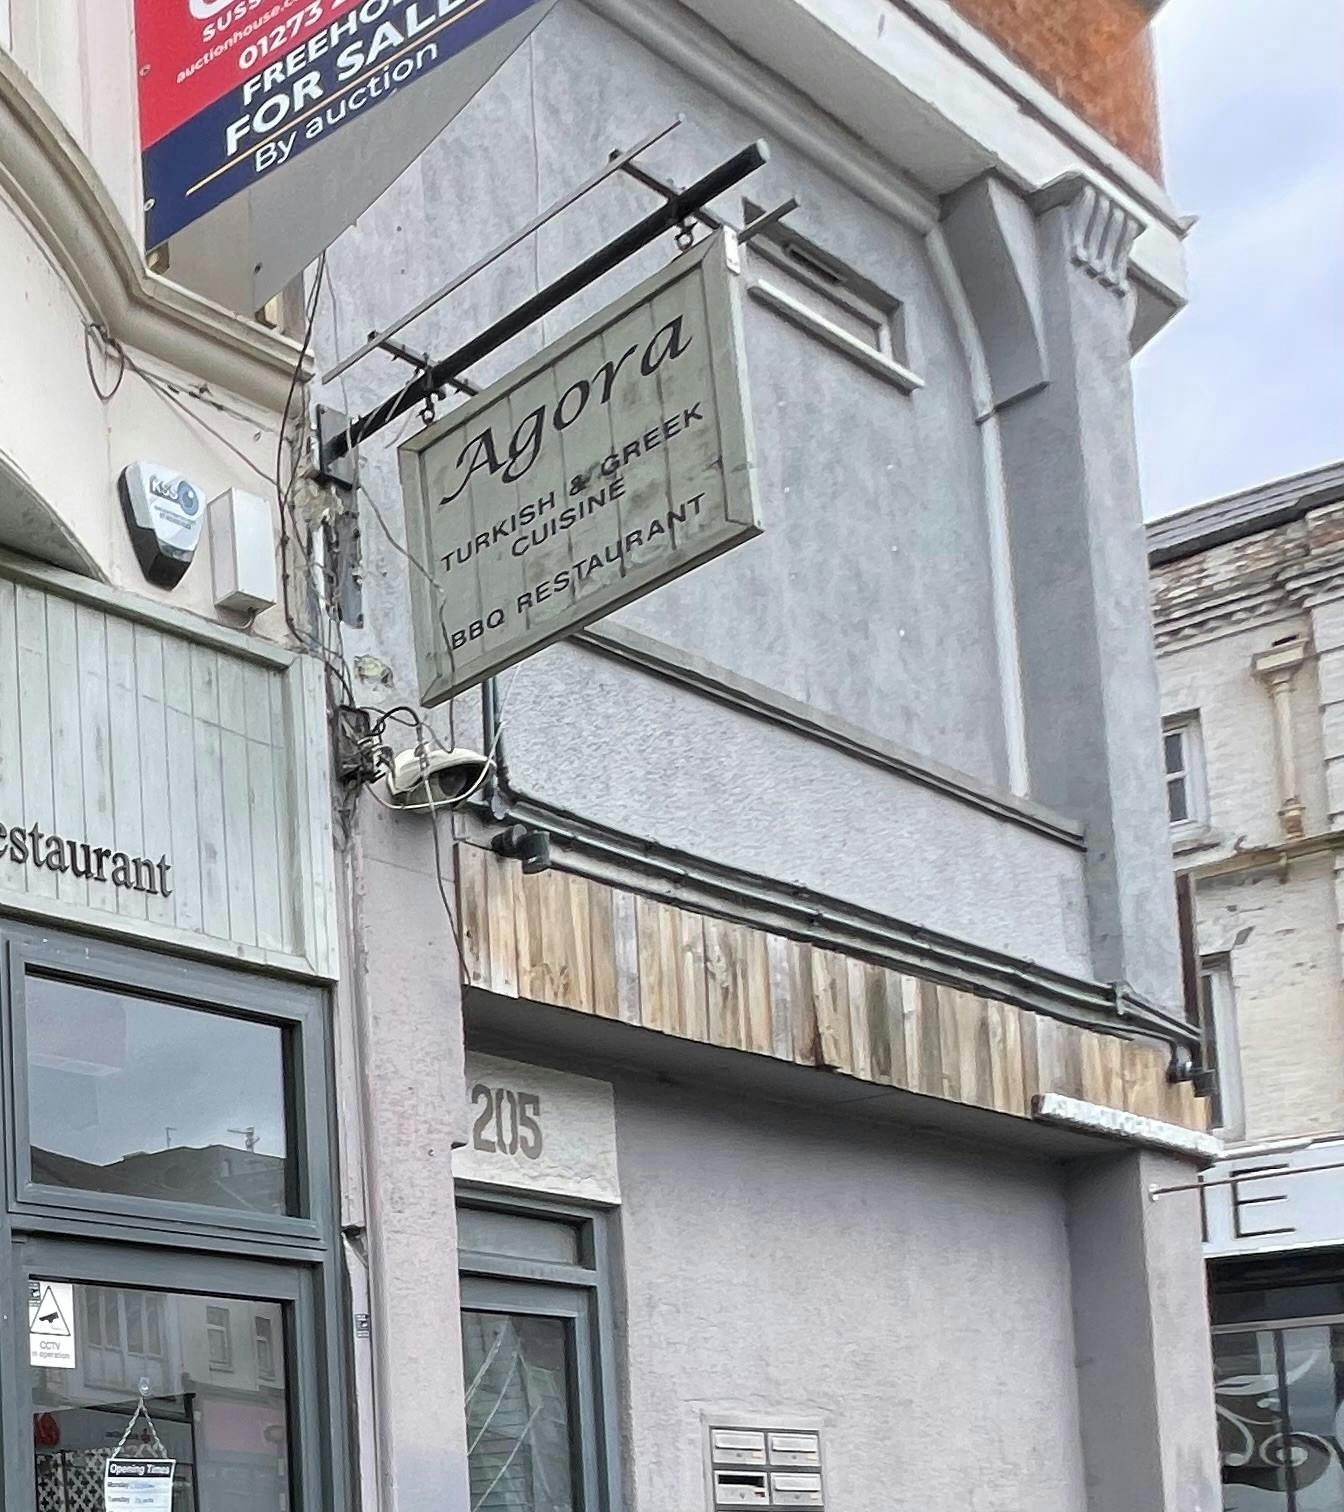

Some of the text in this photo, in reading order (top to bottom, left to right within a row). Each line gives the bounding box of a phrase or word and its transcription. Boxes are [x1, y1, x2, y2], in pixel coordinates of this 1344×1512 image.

[238, 4, 324, 69] 01273
[242, 0, 404, 105] FREEHO
[225, 70, 324, 156] FOR
[255, 42, 438, 173] By auction
[439, 315, 693, 505] Agora
[440, 402, 703, 572] TURKISH & GREEK
[511, 479, 627, 557] CUISINE
[451, 493, 706, 650] BBQ RESTAURANT
[471, 1083, 543, 1159] 205
[110, 1463, 145, 1475] Opening
